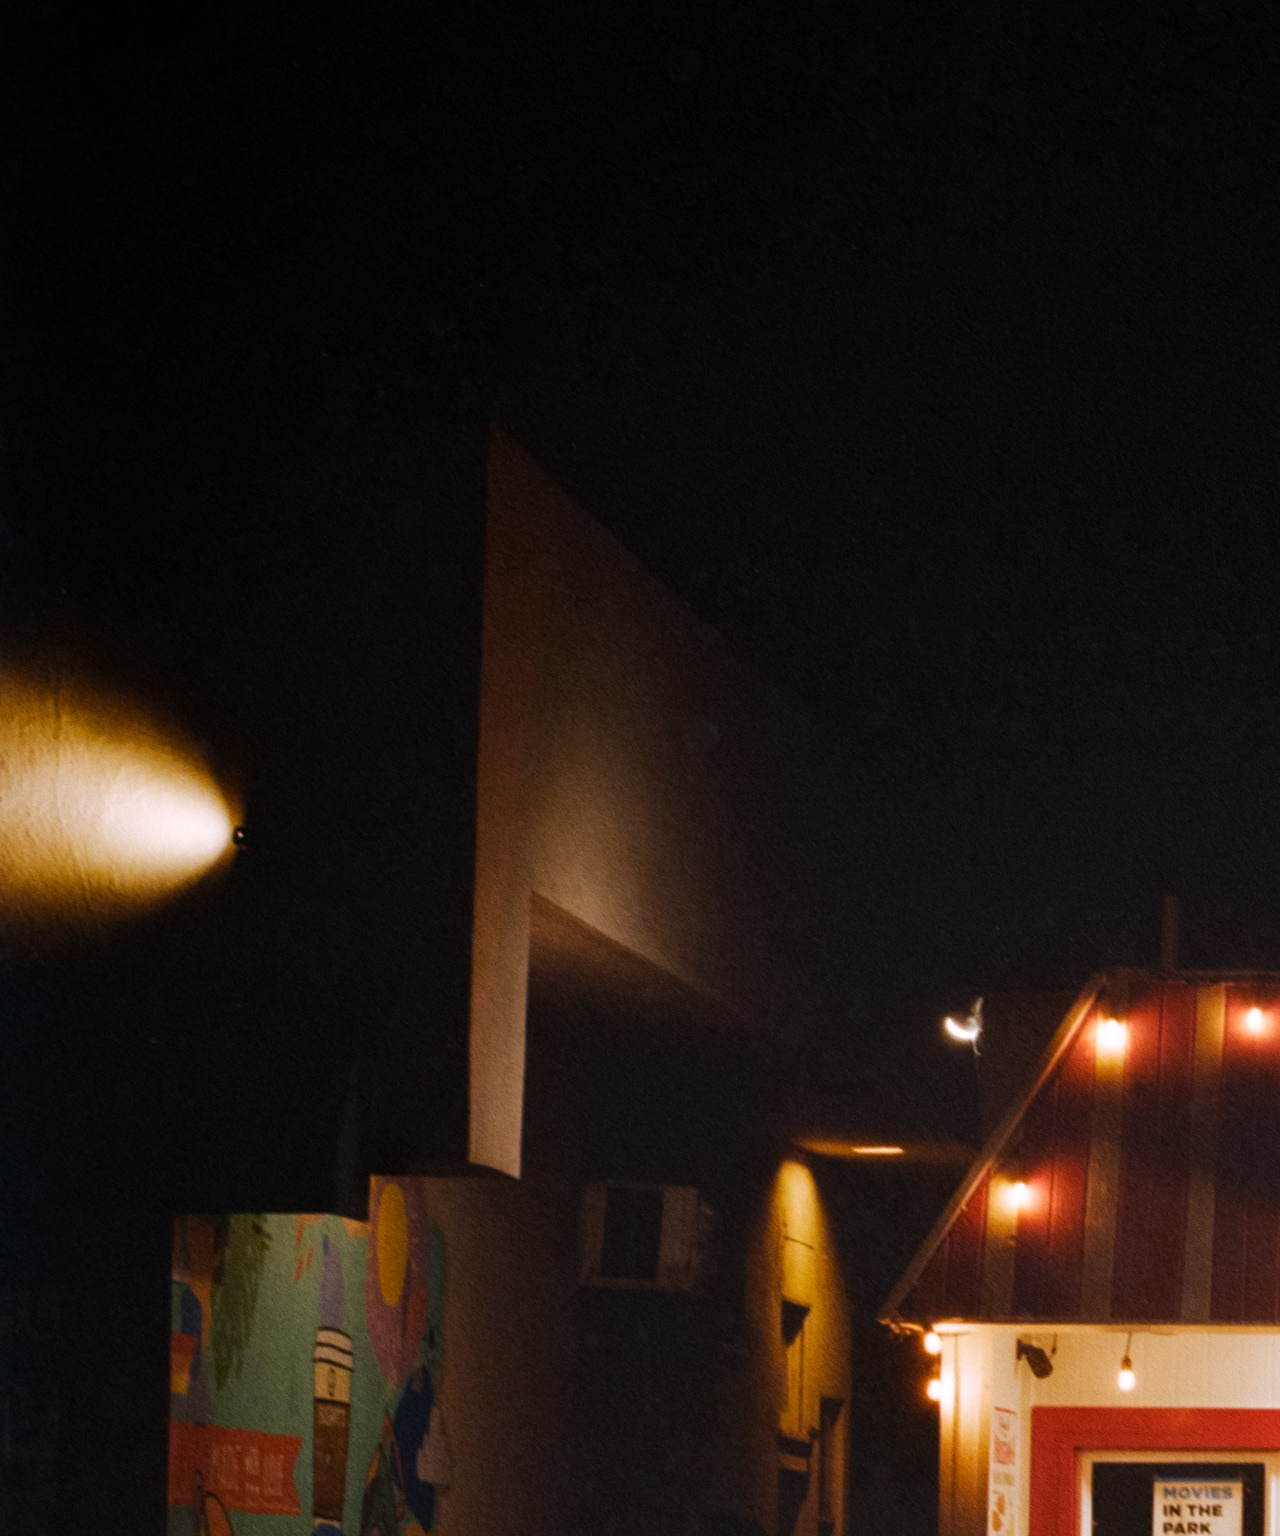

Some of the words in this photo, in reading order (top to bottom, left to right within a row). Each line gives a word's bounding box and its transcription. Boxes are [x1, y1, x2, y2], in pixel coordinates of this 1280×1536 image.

[1163, 1487, 1232, 1499] MOVIES
[1163, 1504, 1181, 1517] IN
[1187, 1504, 1223, 1517] THE
[1163, 1522, 1211, 1535] PARK
